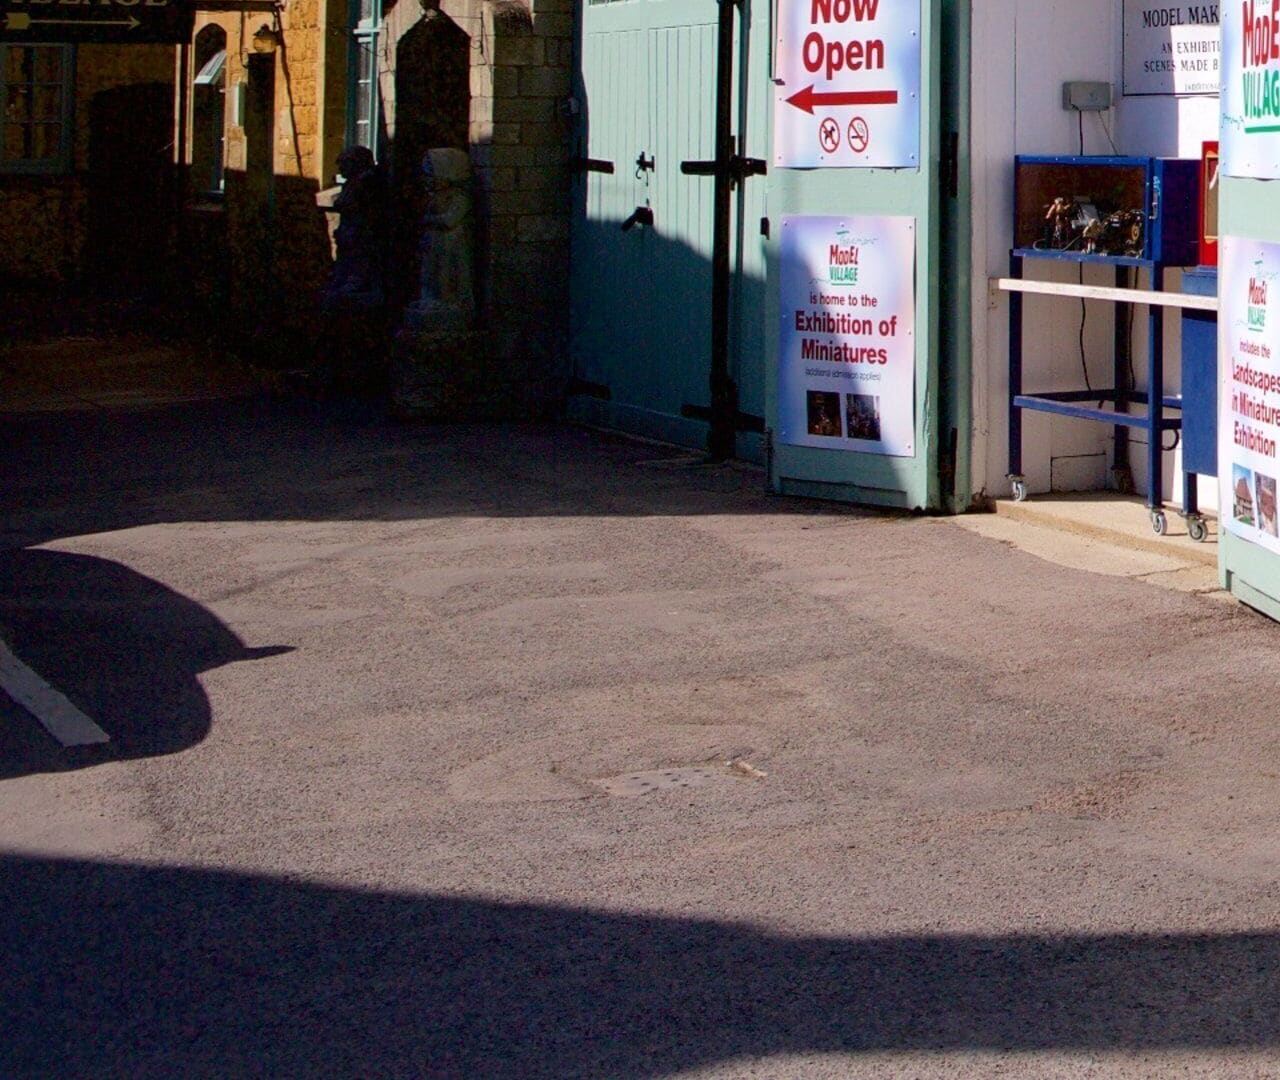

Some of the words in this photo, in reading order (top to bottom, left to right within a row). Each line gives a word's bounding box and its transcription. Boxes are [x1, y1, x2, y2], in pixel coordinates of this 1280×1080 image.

[1142, 7, 1184, 28] MODEL
[803, 32, 884, 80] Open
[1161, 41, 1173, 55] AN
[1144, 60, 1176, 72] SCENES
[1181, 59, 1208, 72] MADE
[830, 266, 858, 281] VILLAGE
[810, 292, 818, 304] is
[820, 293, 845, 306] home
[848, 294, 858, 307] to
[861, 294, 878, 308] the
[795, 310, 872, 335] Exhibition
[879, 315, 897, 336] of
[801, 338, 887, 364] Miniatures
[1240, 338, 1260, 356] includes
[1261, 344, 1271, 359] the
[1232, 388, 1238, 412] in
[1234, 420, 1276, 458] Exhibition
